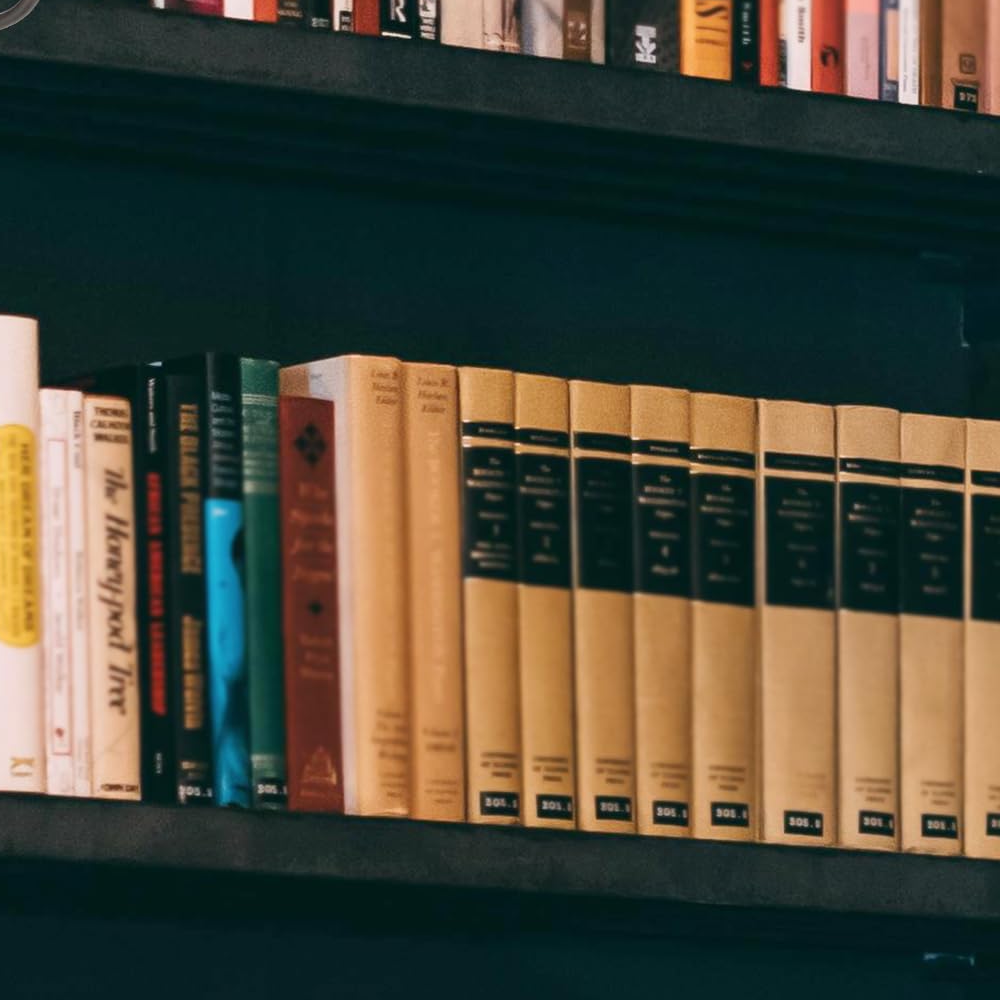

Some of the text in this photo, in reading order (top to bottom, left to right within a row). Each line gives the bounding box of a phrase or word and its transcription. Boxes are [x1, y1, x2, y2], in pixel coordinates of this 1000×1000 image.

[741, 2, 754, 46] Smith
[796, 6, 809, 44] Smith
[179, 402, 201, 489] THE BLACK
[19, 442, 33, 633] HER DREAM OF DREAMS
[98, 468, 133, 717] The Honey-pod Tree
